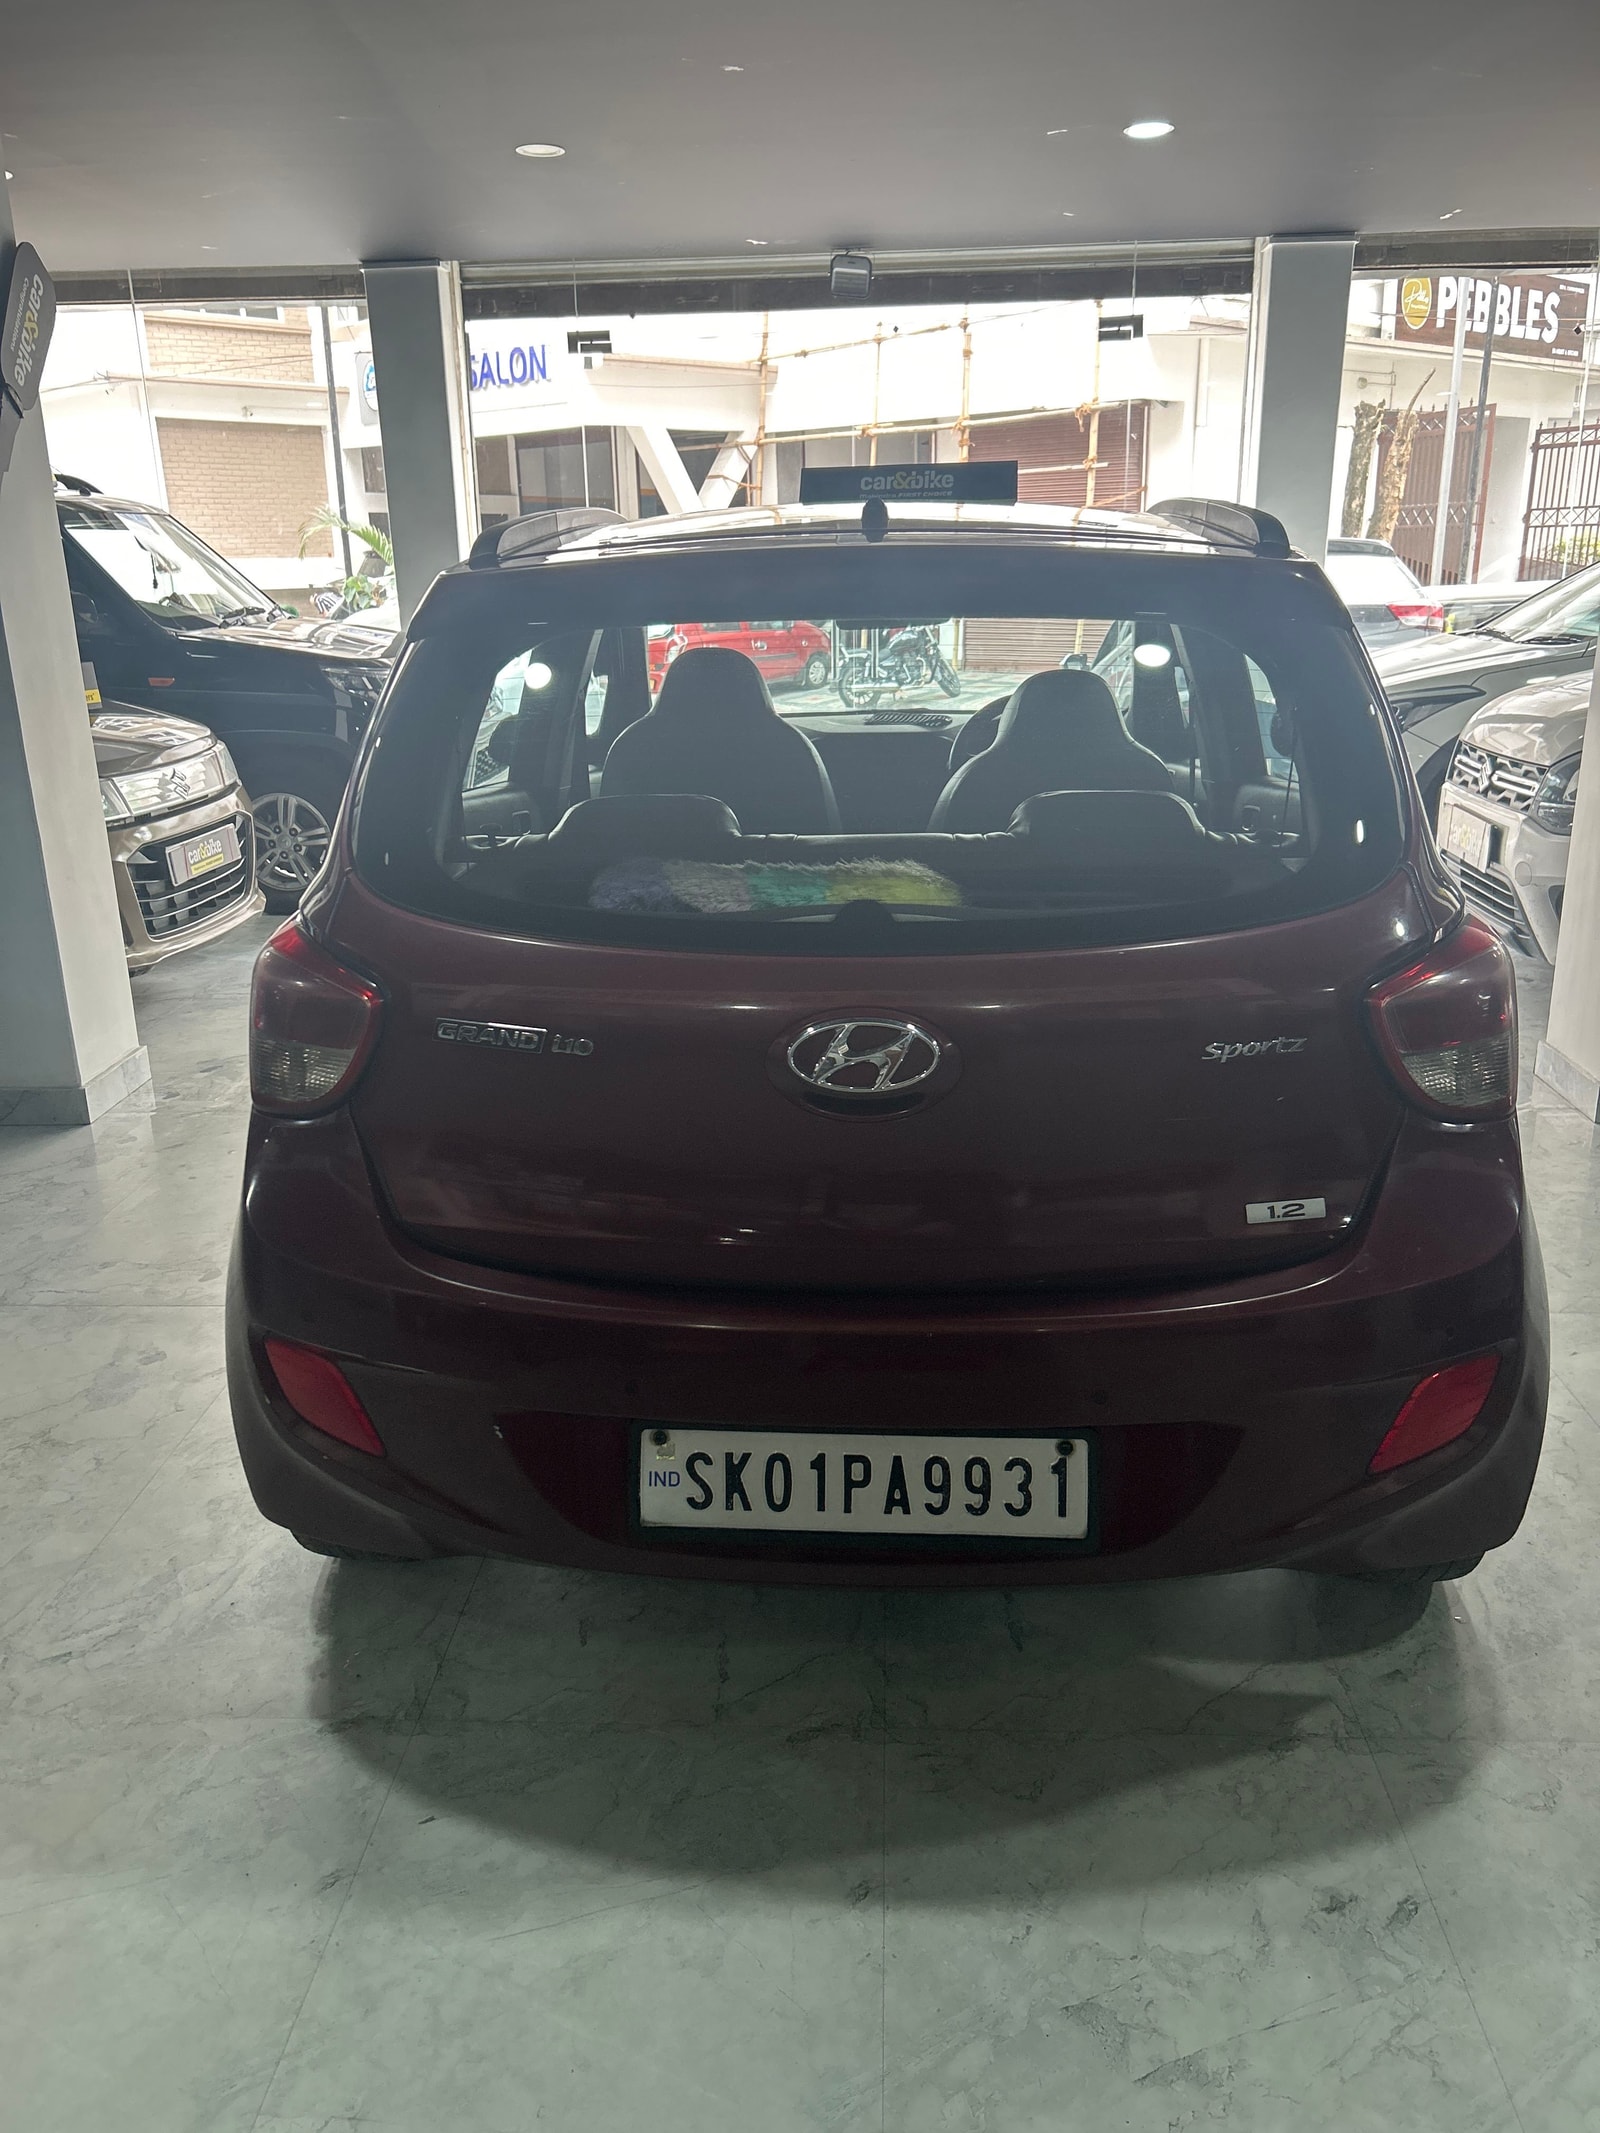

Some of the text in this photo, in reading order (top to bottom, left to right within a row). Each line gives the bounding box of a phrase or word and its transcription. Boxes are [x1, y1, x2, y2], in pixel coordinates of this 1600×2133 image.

[15, 274, 43, 387] car&bike
[860, 470, 954, 490] car&bike
[188, 839, 222, 864] car&bike
[438, 1022, 539, 1050] GRAND
[1267, 1203, 1306, 1219] 1.2
[648, 1451, 1069, 1518] IND SK01PA9931
